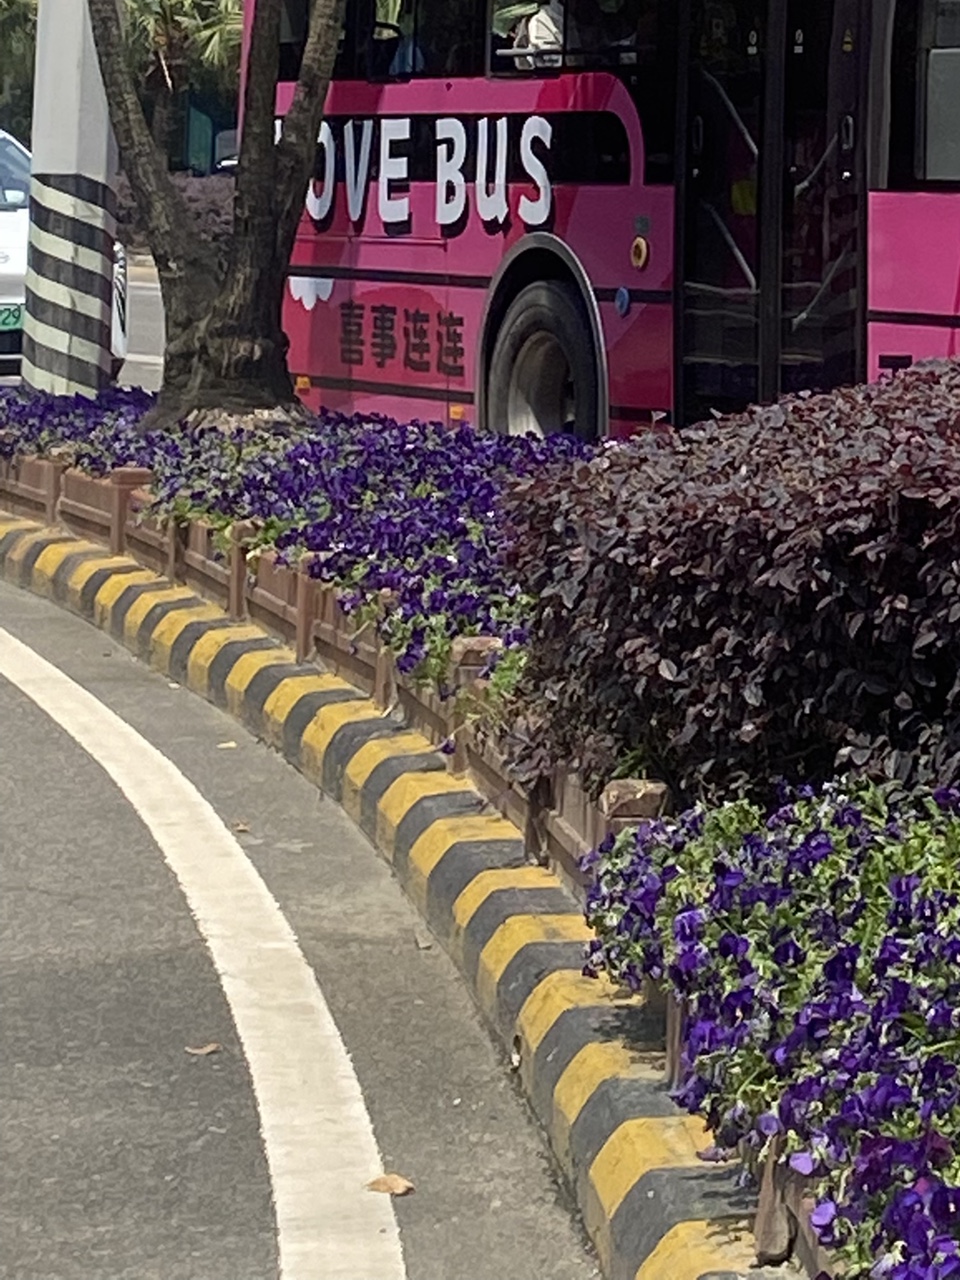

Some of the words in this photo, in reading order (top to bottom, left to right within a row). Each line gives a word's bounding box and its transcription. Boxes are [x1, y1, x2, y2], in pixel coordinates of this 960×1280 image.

[274, 117, 412, 223] OVE
[435, 115, 552, 226] BUS
[339, 299, 465, 377] 喜事连连
